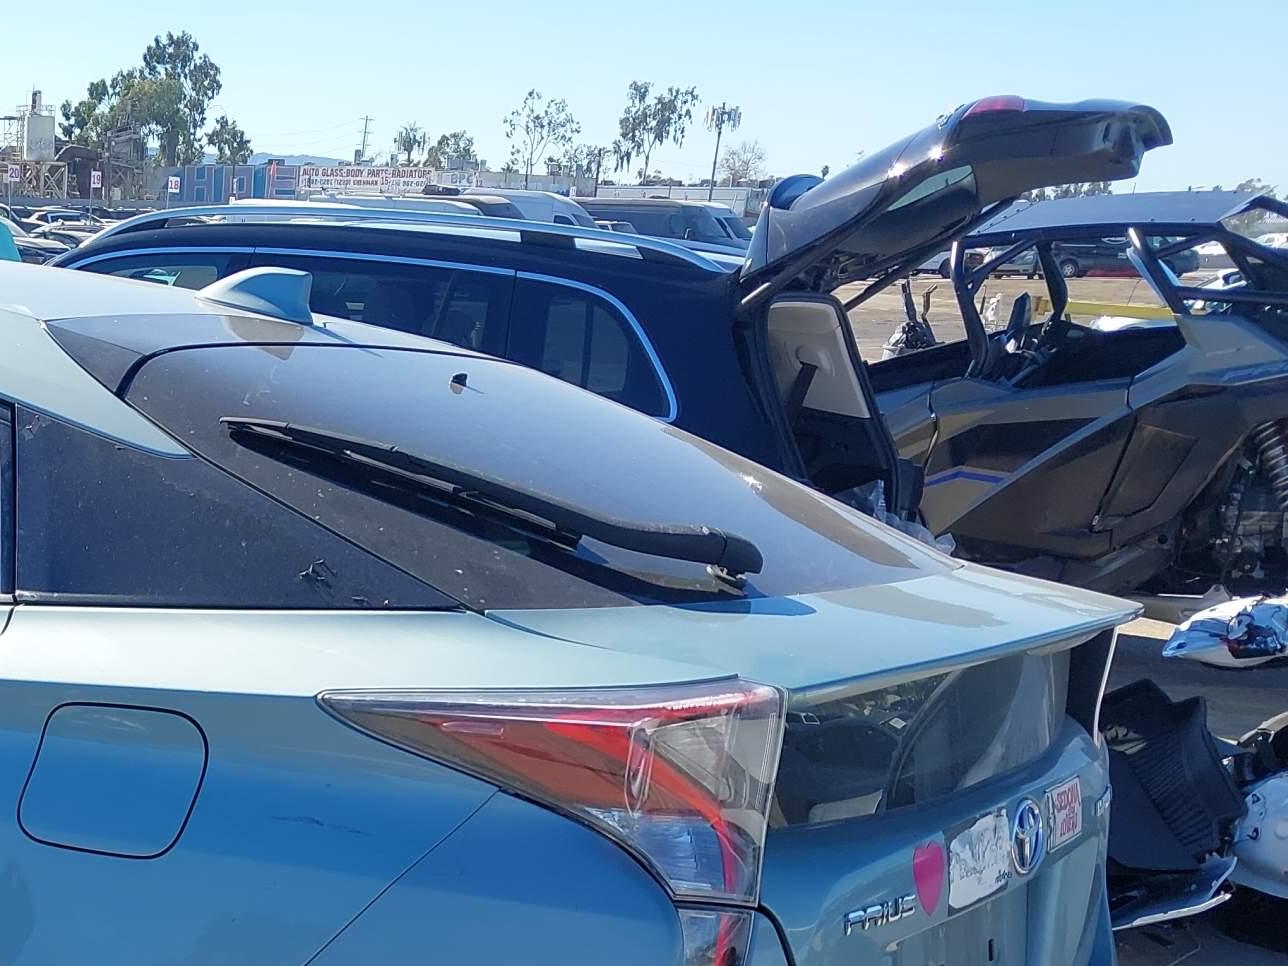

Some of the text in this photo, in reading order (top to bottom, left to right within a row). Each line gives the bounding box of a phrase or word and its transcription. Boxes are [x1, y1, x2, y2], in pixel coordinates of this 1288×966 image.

[9, 168, 20, 178] 20
[92, 174, 101, 185] 19
[169, 180, 179, 190] 18
[844, 894, 916, 936] PRIUS
